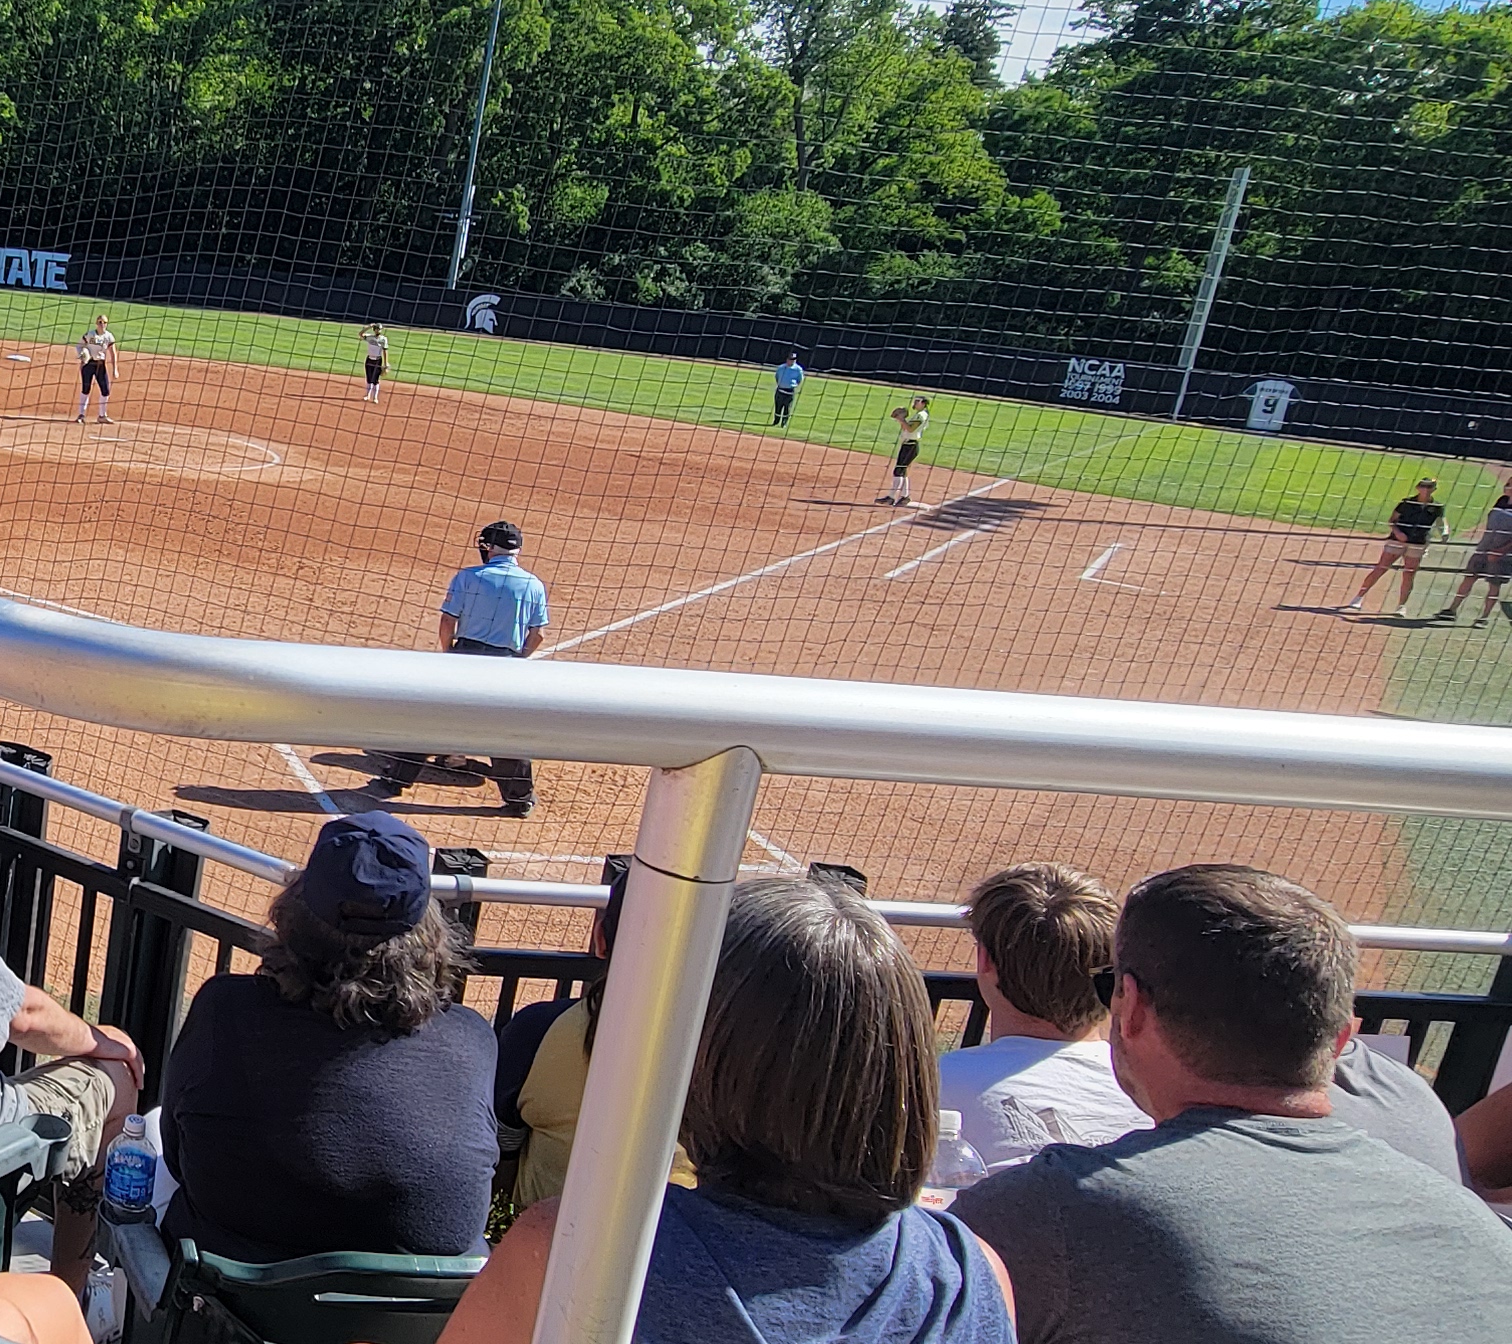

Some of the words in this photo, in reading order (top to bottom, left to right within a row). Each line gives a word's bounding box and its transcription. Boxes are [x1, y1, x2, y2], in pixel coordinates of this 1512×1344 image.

[1068, 357, 1125, 379] NCAA
[1059, 388, 1089, 400] 2003
[1090, 392, 1120, 404] 2004
[1262, 398, 1278, 414] 9
